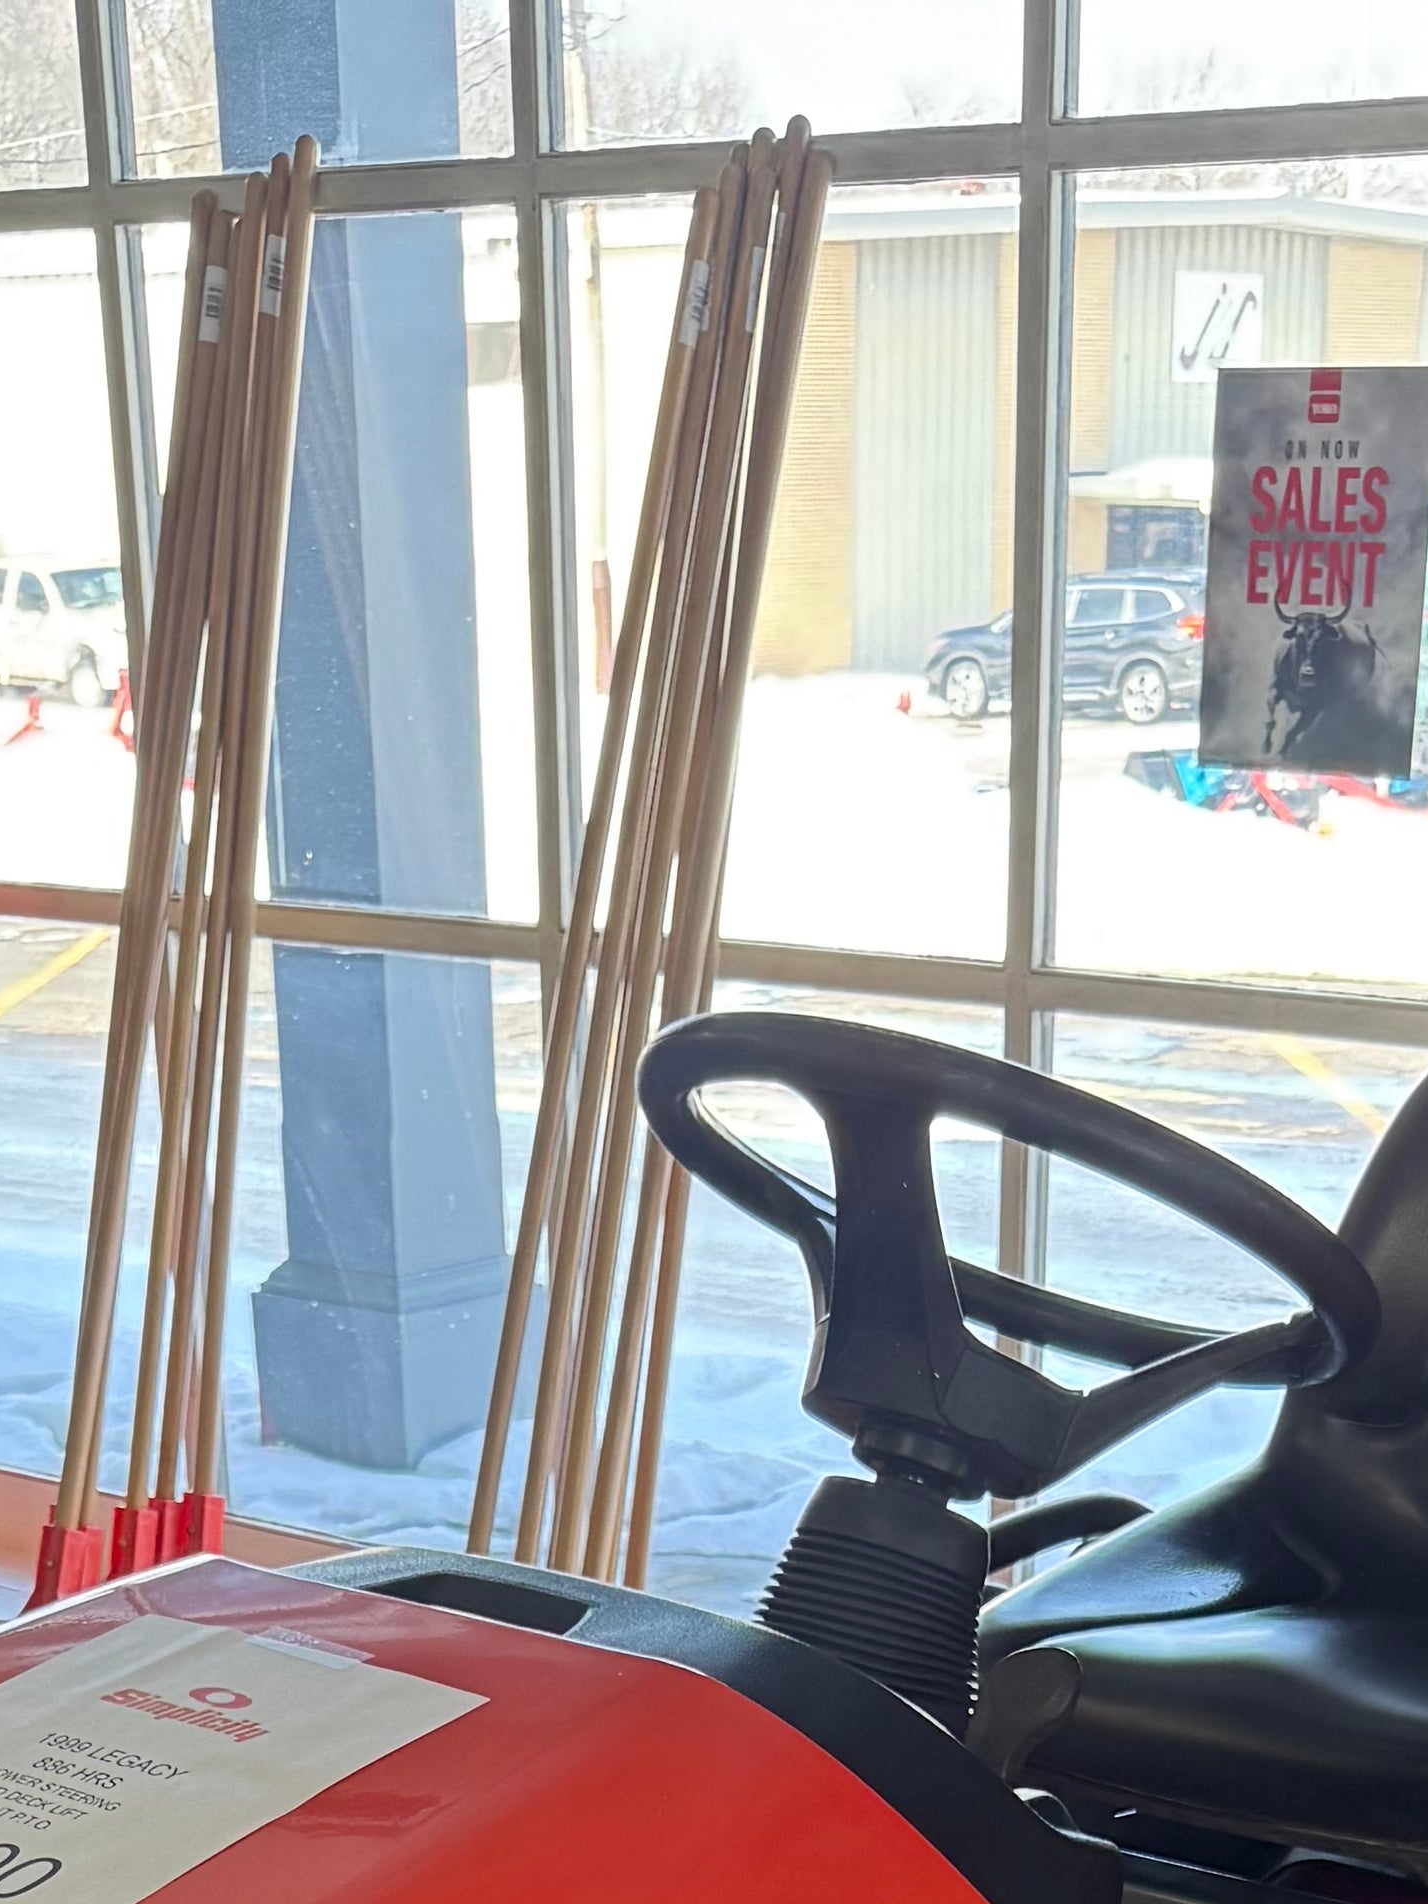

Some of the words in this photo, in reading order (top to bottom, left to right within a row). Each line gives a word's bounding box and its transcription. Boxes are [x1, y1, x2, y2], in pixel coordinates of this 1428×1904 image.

[1284, 440, 1308, 460] ON
[1320, 440, 1360, 460] NOW
[1249, 465, 1390, 534] SALES
[1246, 540, 1386, 608] EVENT
[100, 1688, 270, 1743] Simplicity
[32, 1756, 76, 1774] 886
[72, 1767, 124, 1790] HRS
[38, 1732, 93, 1753] 1999
[87, 1746, 189, 1780] LEGACY
[4, 1791, 55, 1810] DECK
[49, 1804, 88, 1820] LIFT
[39, 1779, 122, 1811] STEERING
